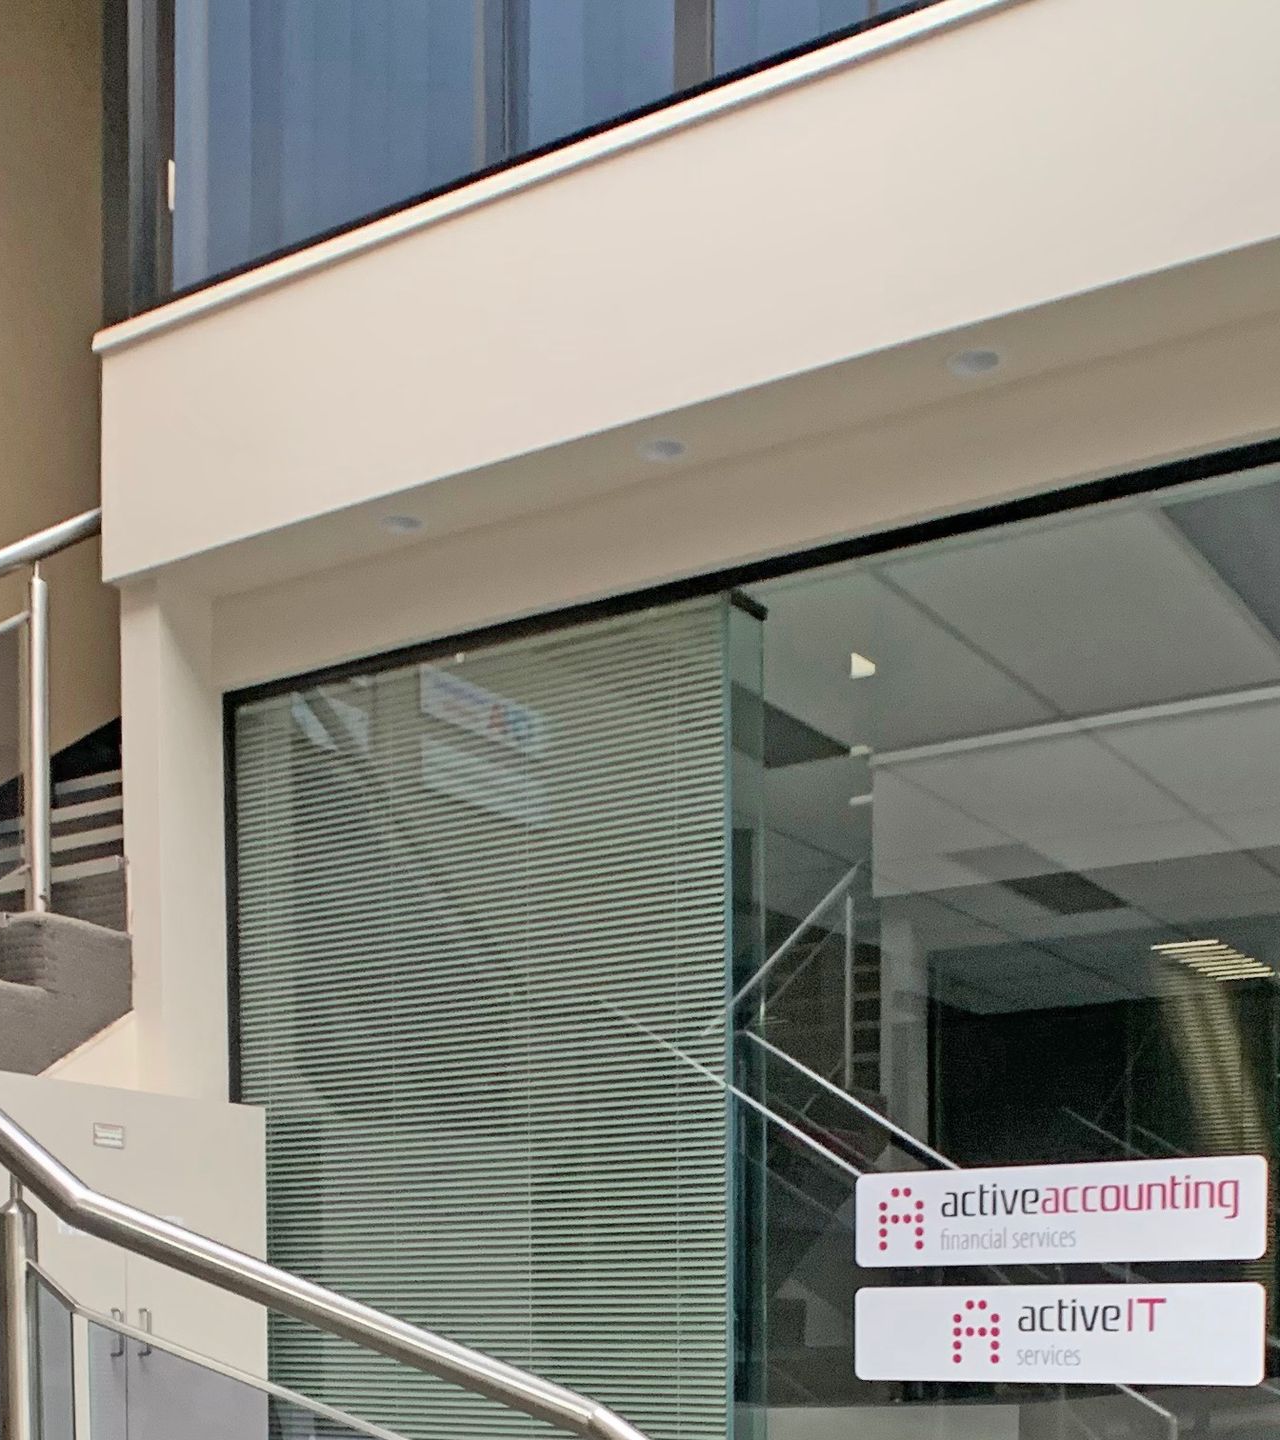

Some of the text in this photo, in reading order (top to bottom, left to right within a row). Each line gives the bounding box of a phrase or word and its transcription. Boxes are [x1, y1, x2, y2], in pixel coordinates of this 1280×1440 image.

[940, 1175, 1240, 1219] activeaccounting
[940, 1228, 1076, 1251] financial services
[1017, 1297, 1167, 1332] activeIT
[1016, 1346, 1081, 1366] services
